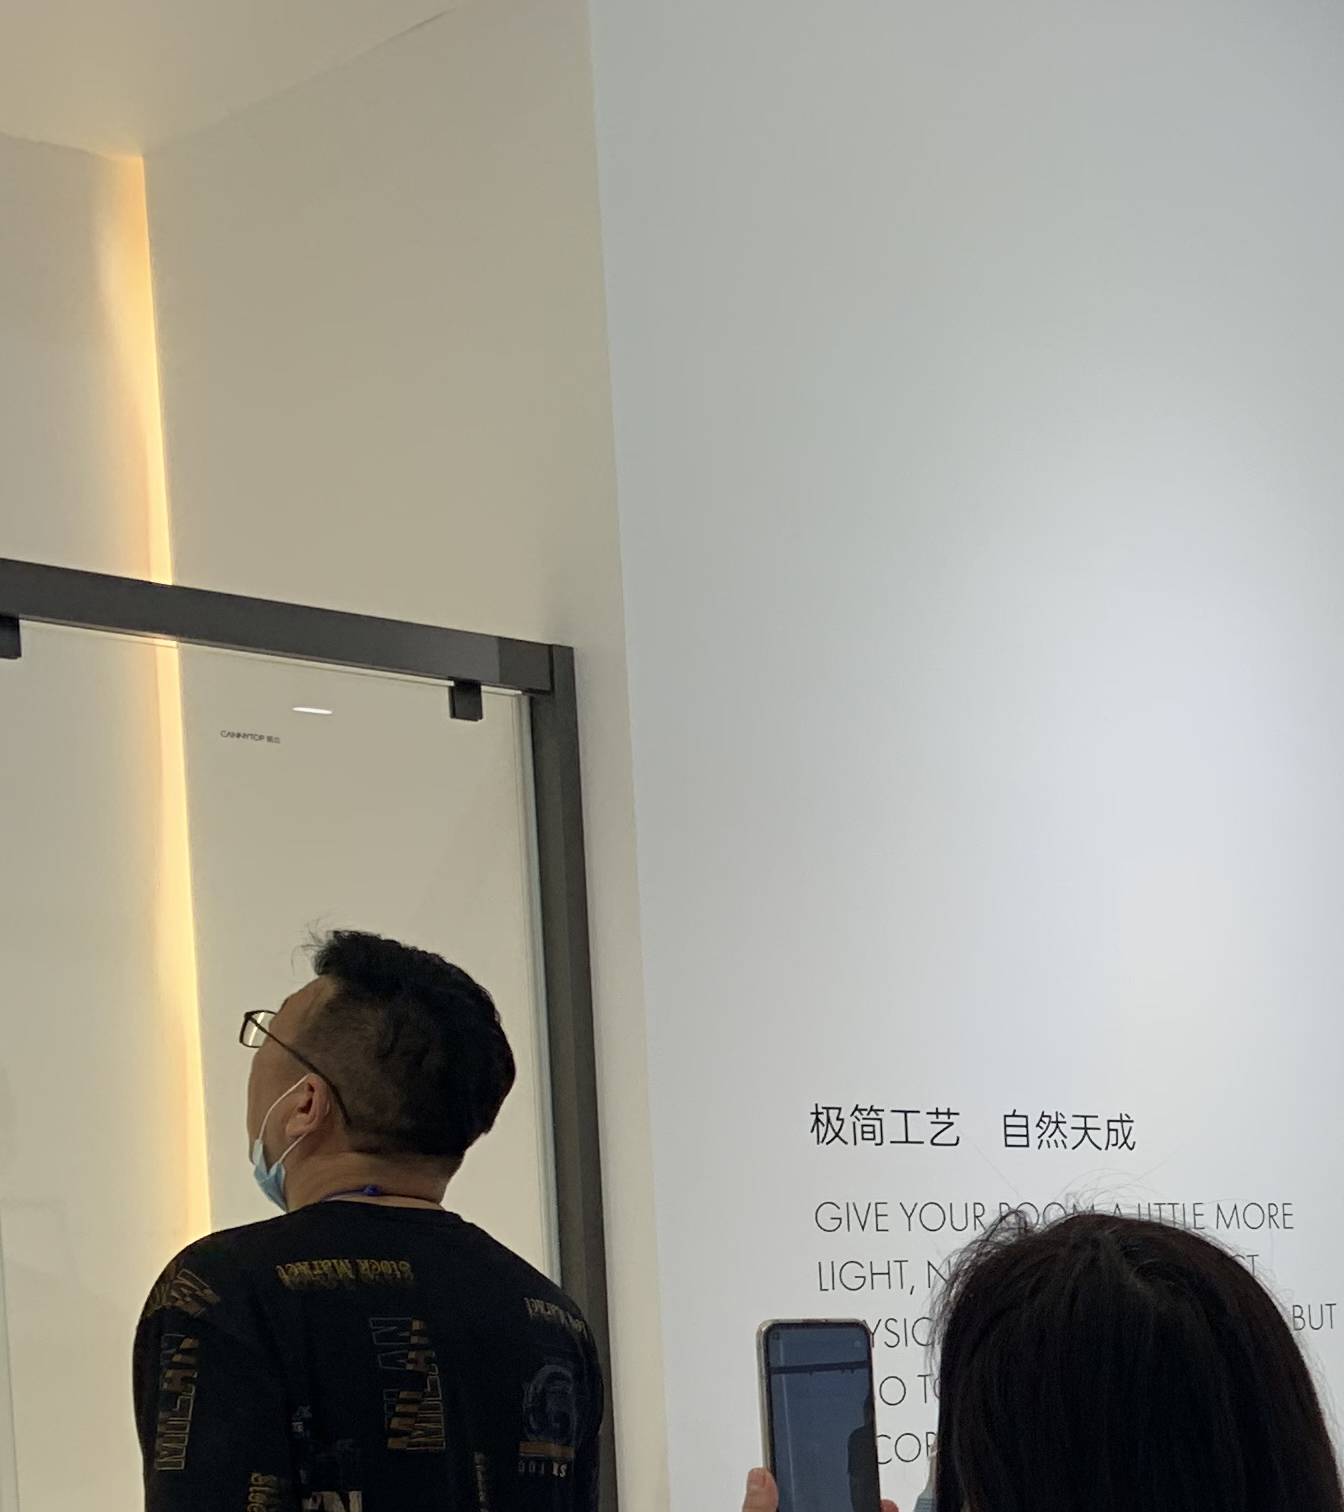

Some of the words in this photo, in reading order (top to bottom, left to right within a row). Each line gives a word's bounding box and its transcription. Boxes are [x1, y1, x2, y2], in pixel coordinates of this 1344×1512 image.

[809, 1102, 961, 1147] 极简工艺
[1003, 1108, 1137, 1152] 自然天成
[814, 1201, 889, 1232] GIVE
[899, 1201, 986, 1232] YOUR
[1215, 1202, 1294, 1230] MORE
[818, 1260, 915, 1295] LIGHT,
[1292, 1303, 1337, 1331] BUT
